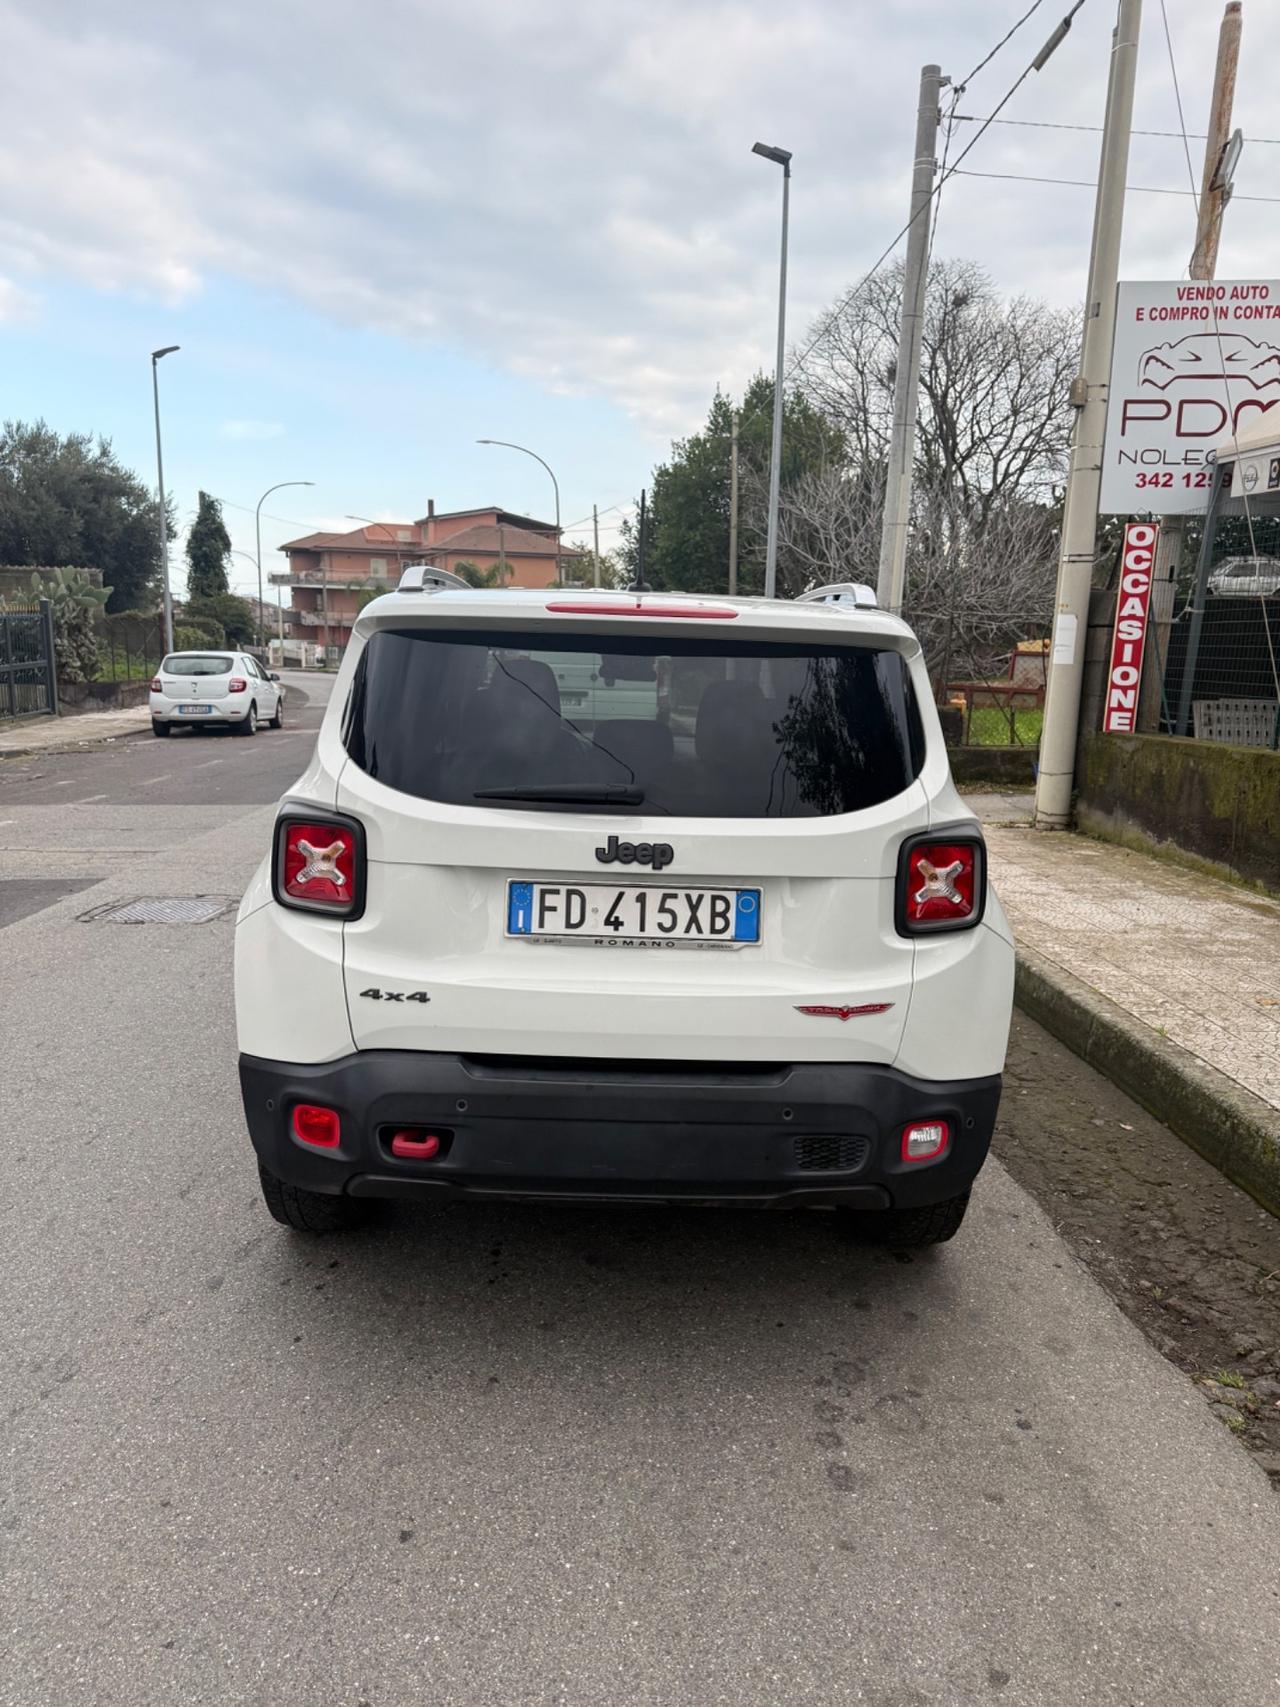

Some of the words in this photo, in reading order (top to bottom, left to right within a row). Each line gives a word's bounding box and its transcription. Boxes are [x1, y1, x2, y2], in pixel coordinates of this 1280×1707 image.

[1177, 287, 1226, 301] VENDO
[1230, 286, 1269, 300] AUTO
[1135, 307, 1145, 321] E
[1149, 306, 1210, 321] COMPRO
[1215, 306, 1229, 320] IN
[1135, 472, 1173, 488] 342
[1109, 525, 1154, 731] OCCASIONE
[595, 836, 674, 870] Jeep
[518, 909, 524, 928] I
[537, 888, 587, 930] FD
[603, 890, 732, 935] 415XB
[594, 938, 676, 948] ROMANO
[359, 988, 431, 1003] 4x4
